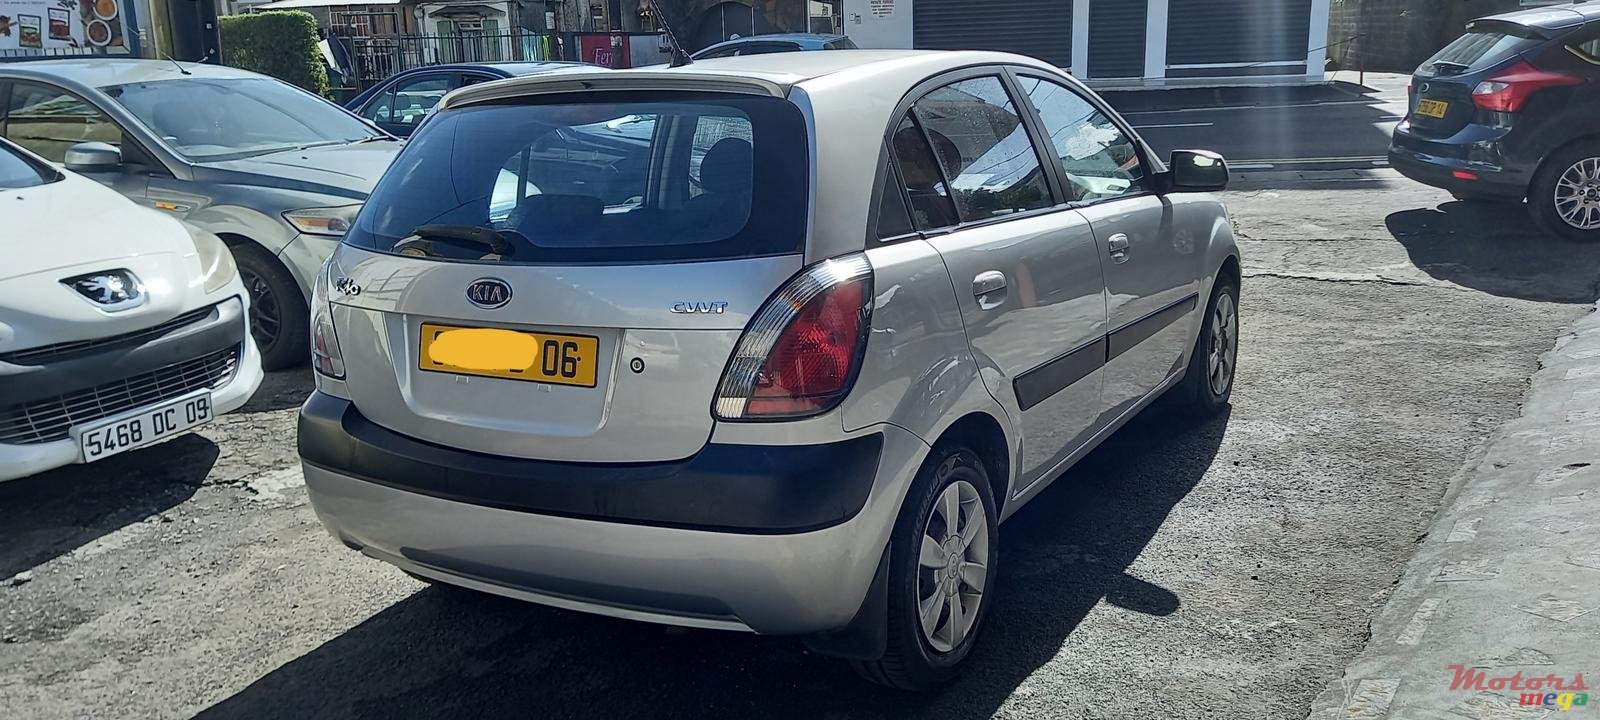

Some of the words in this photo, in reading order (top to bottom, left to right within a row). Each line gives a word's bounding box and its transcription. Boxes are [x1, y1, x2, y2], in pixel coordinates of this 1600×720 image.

[472, 284, 503, 302] KIA
[541, 340, 578, 378] 06
[87, 419, 142, 456] 5468
[152, 408, 177, 436] DC
[185, 398, 209, 424] 09
